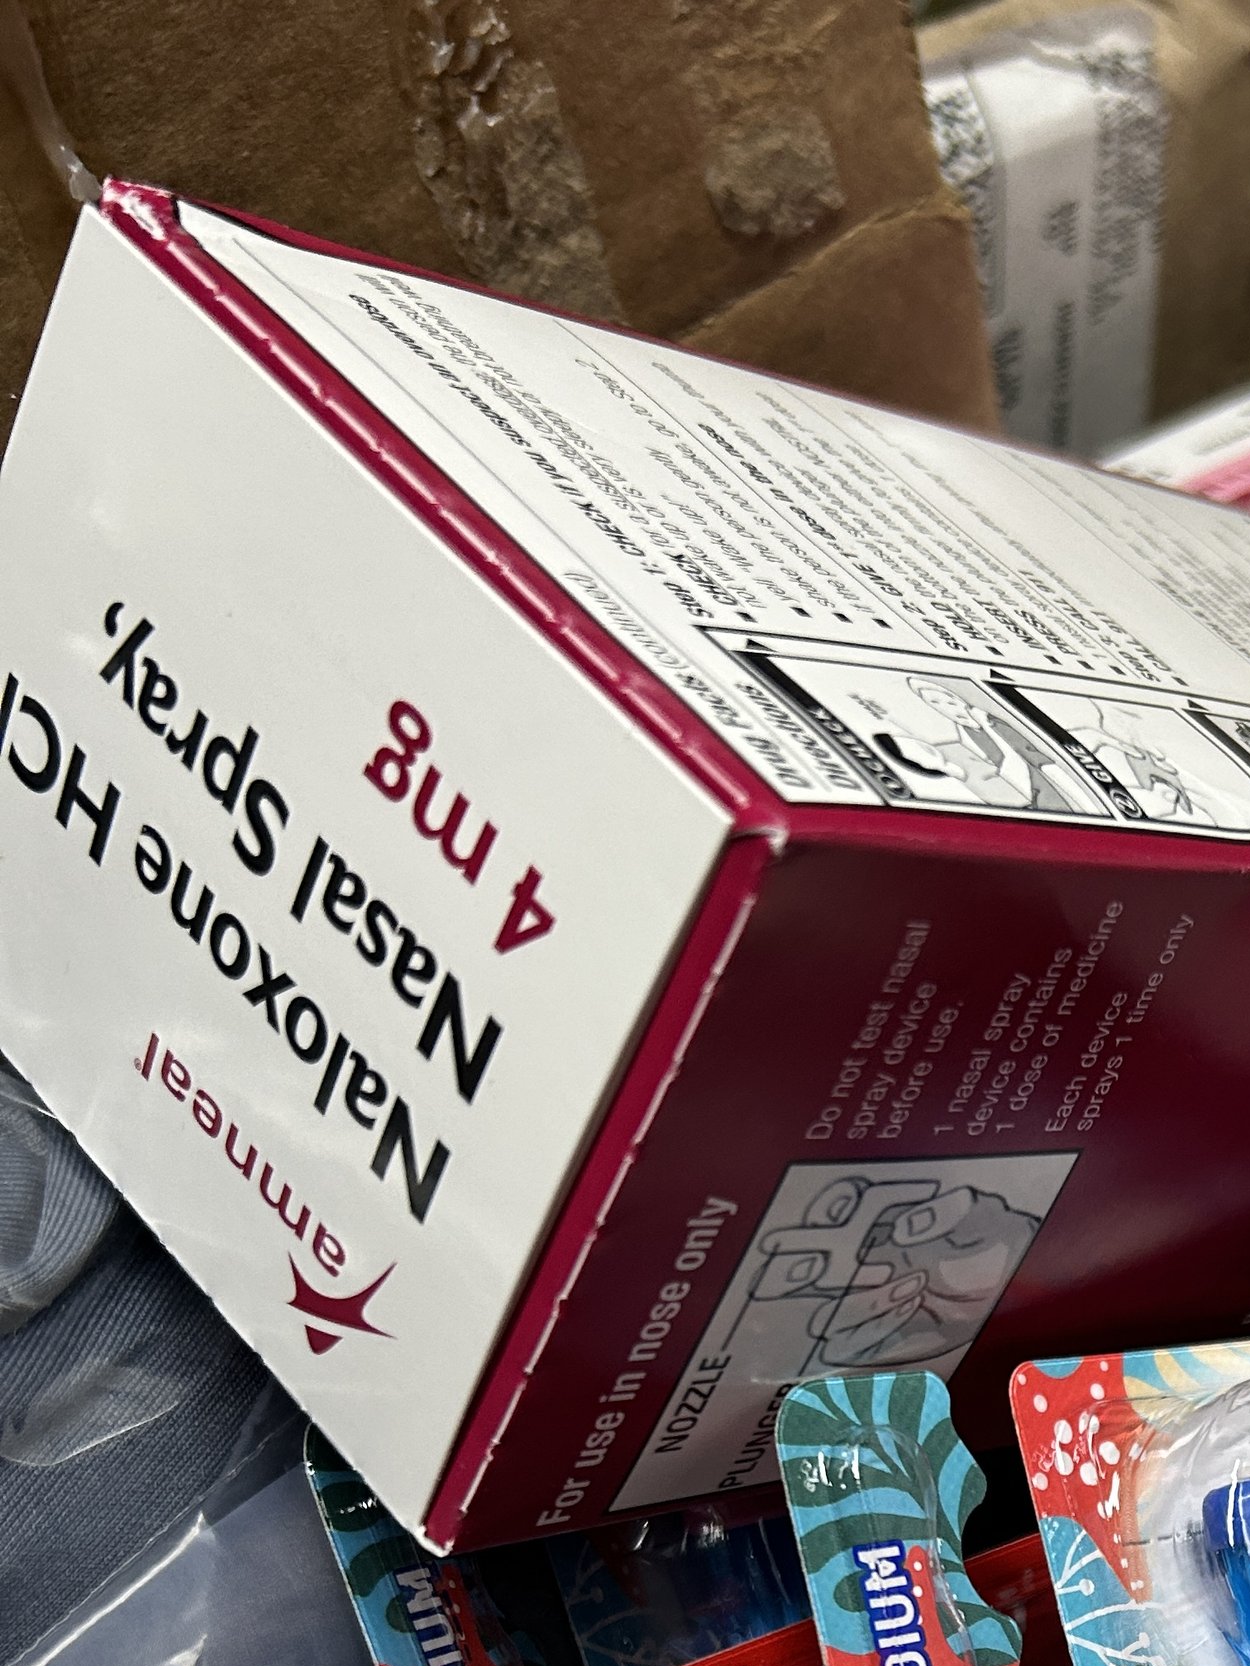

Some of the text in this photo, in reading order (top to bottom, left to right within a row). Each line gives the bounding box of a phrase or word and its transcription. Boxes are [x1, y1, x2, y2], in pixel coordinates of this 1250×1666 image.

[98, 602, 503, 1103] Nasal Spray,
[364, 699, 556, 952] 4 mg
[137, 823, 451, 1224] Naloxone
[143, 1032, 346, 1277] amneal
[535, 1196, 738, 1526] For use in nose only
[653, 1354, 732, 1454] NOZZLE
